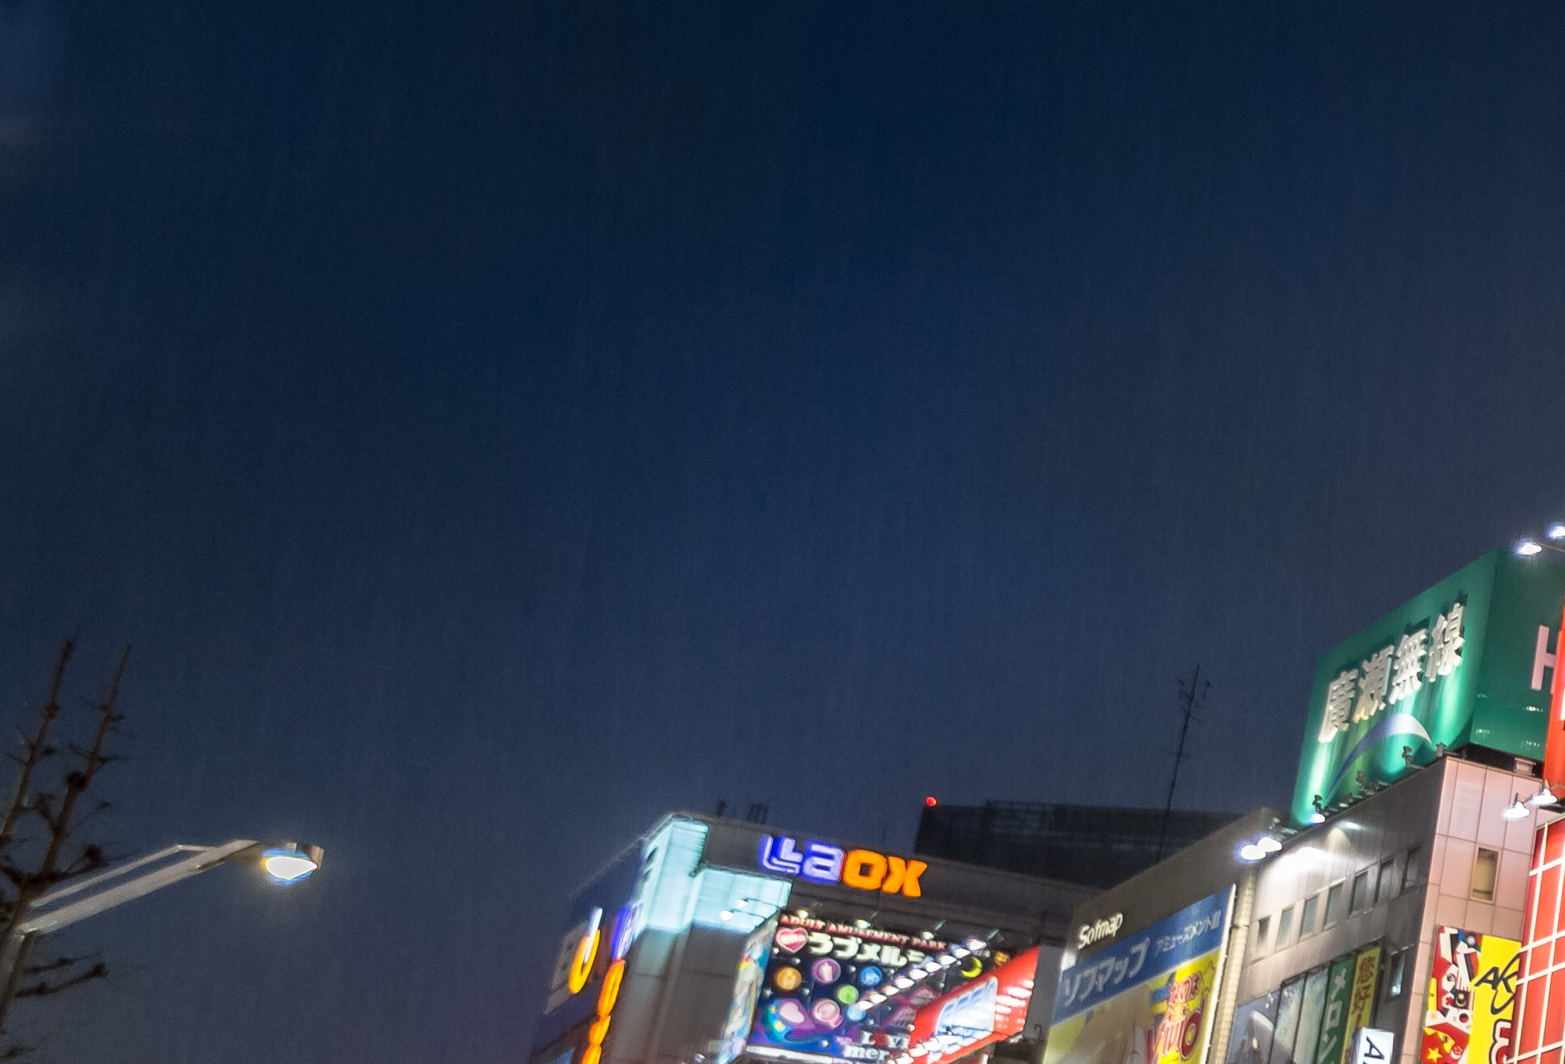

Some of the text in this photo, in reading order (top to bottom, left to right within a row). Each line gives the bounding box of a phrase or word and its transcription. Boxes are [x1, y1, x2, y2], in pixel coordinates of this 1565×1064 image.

[1064, 936, 1150, 1007] ソフマップ
